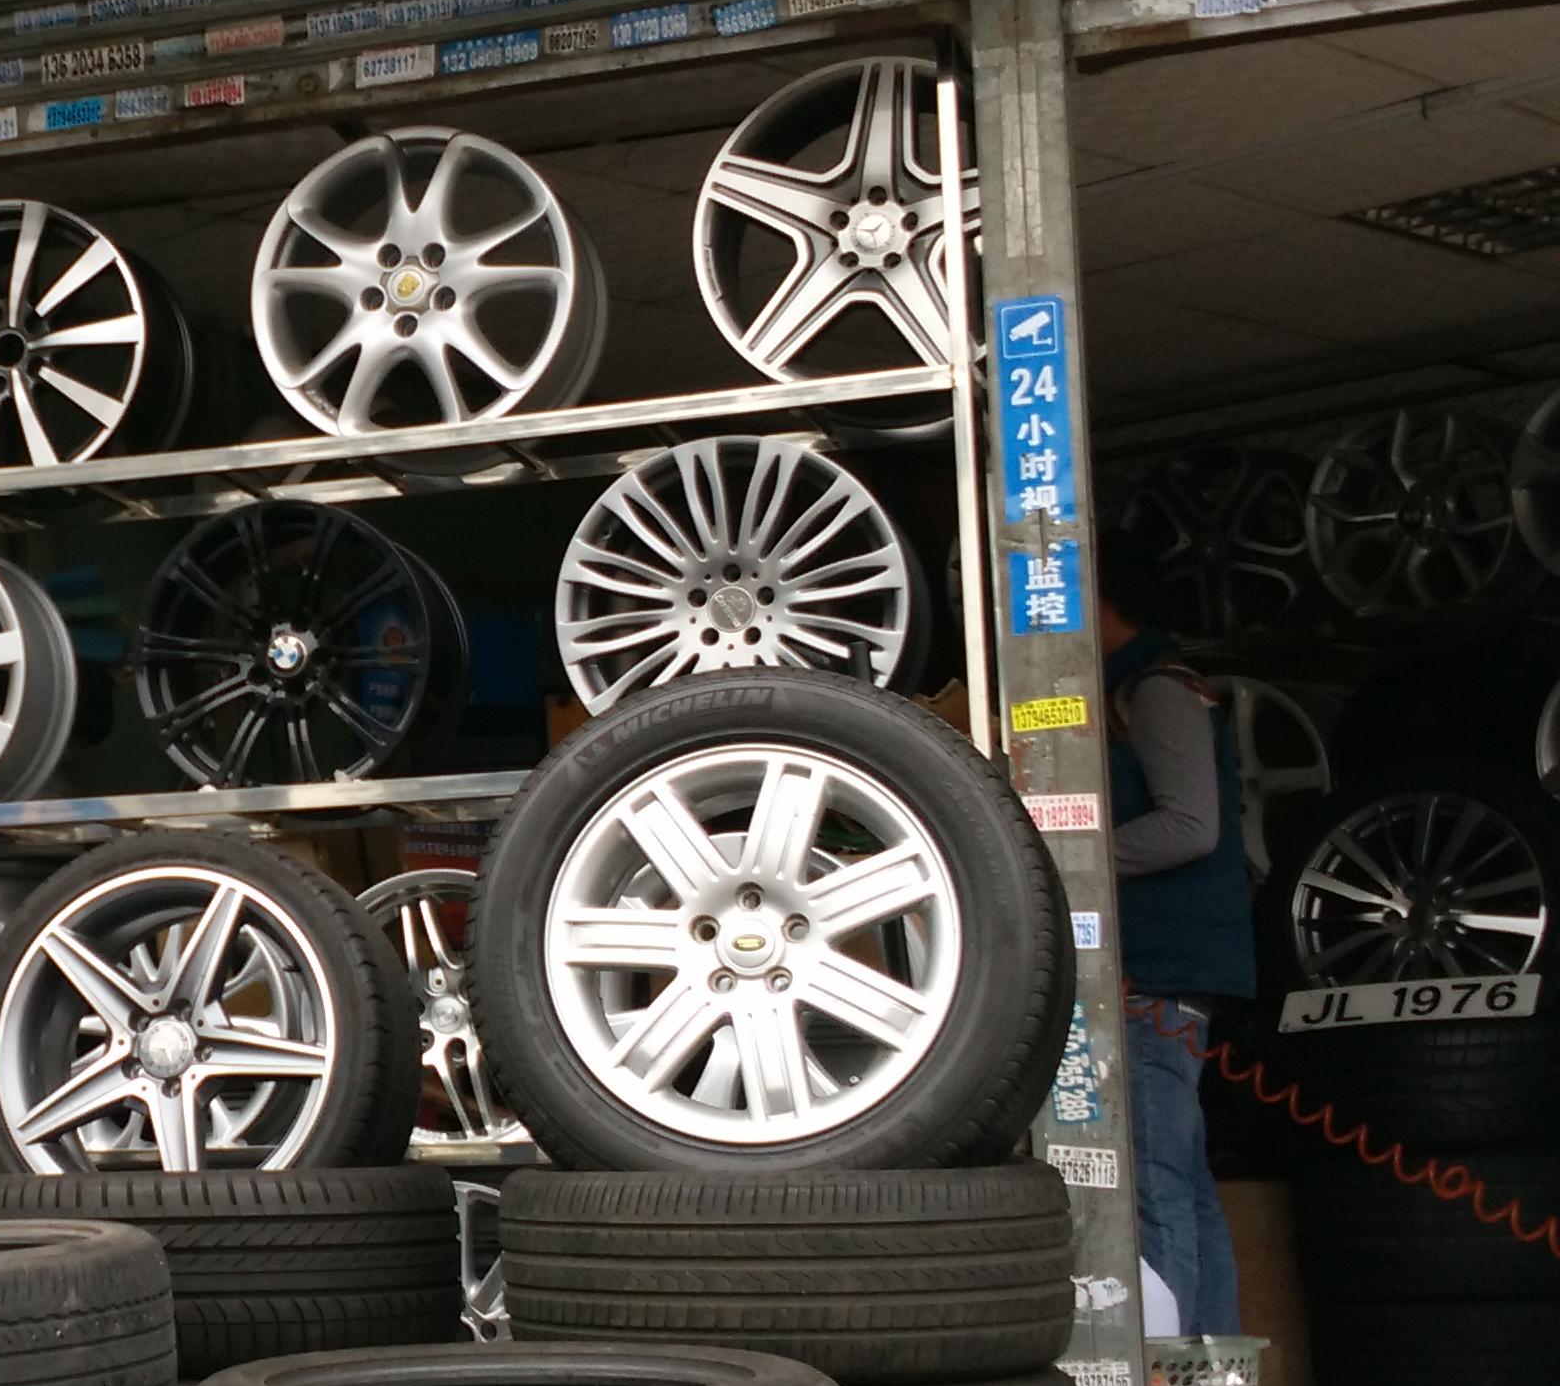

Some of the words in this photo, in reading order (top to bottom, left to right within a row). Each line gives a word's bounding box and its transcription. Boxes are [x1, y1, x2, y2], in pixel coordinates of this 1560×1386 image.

[611, 686, 776, 745] MICHELIN
[1301, 994, 1363, 1024] JL
[1392, 981, 1517, 1018] 1976
